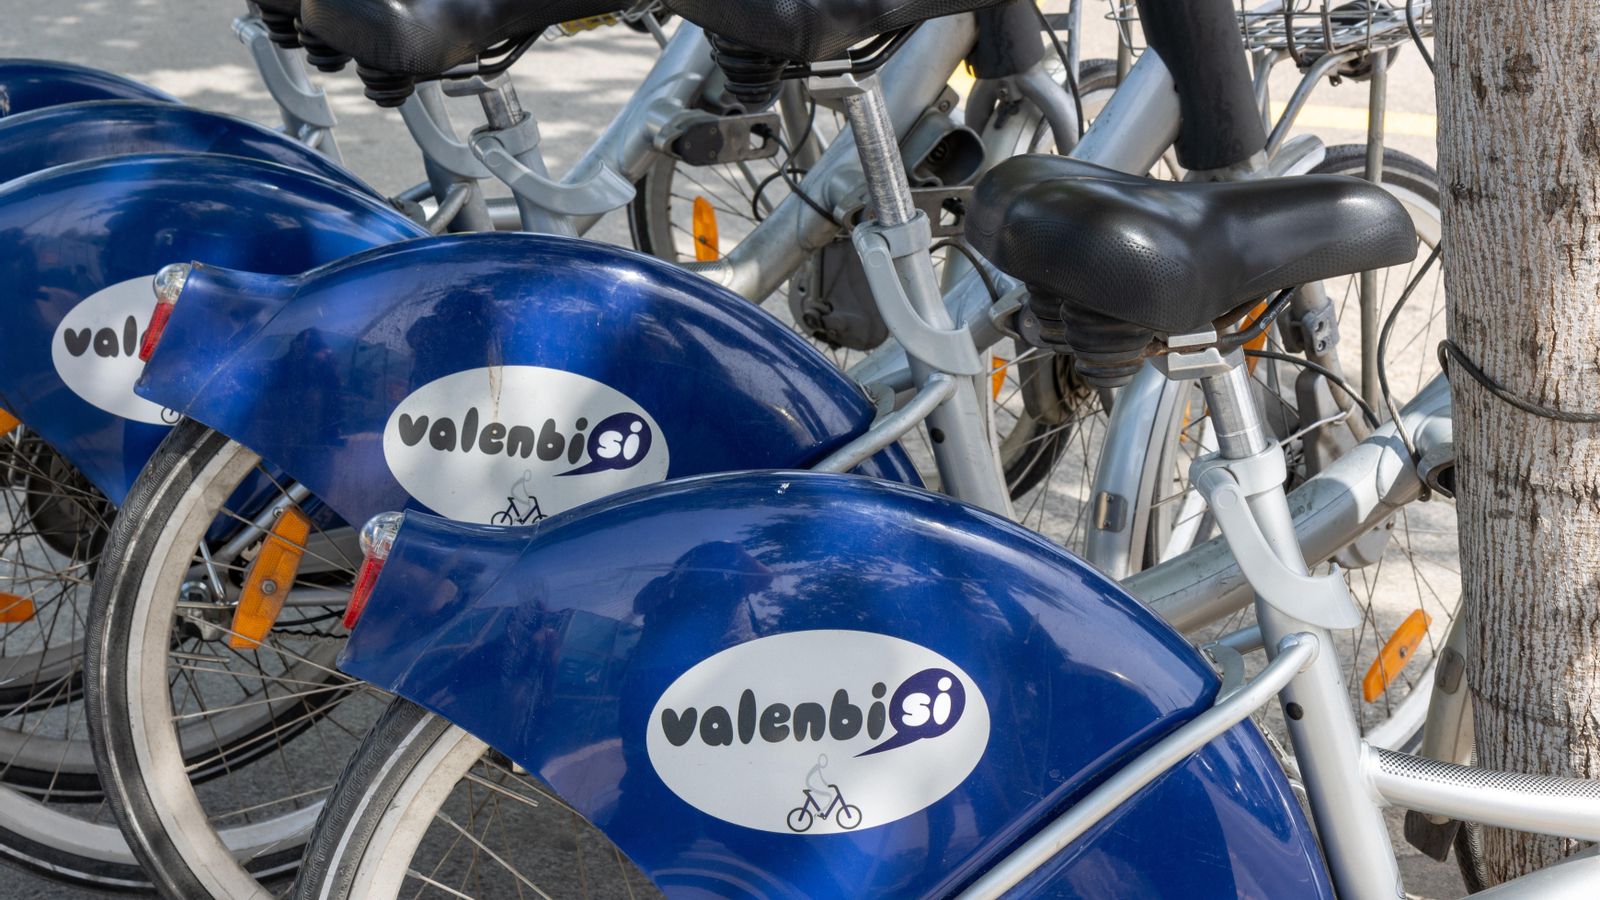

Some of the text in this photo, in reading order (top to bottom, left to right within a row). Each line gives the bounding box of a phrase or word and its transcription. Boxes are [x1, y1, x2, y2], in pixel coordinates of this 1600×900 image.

[64, 315, 147, 358] val
[398, 407, 643, 465] valenbisi
[661, 677, 952, 747] valenbisi
